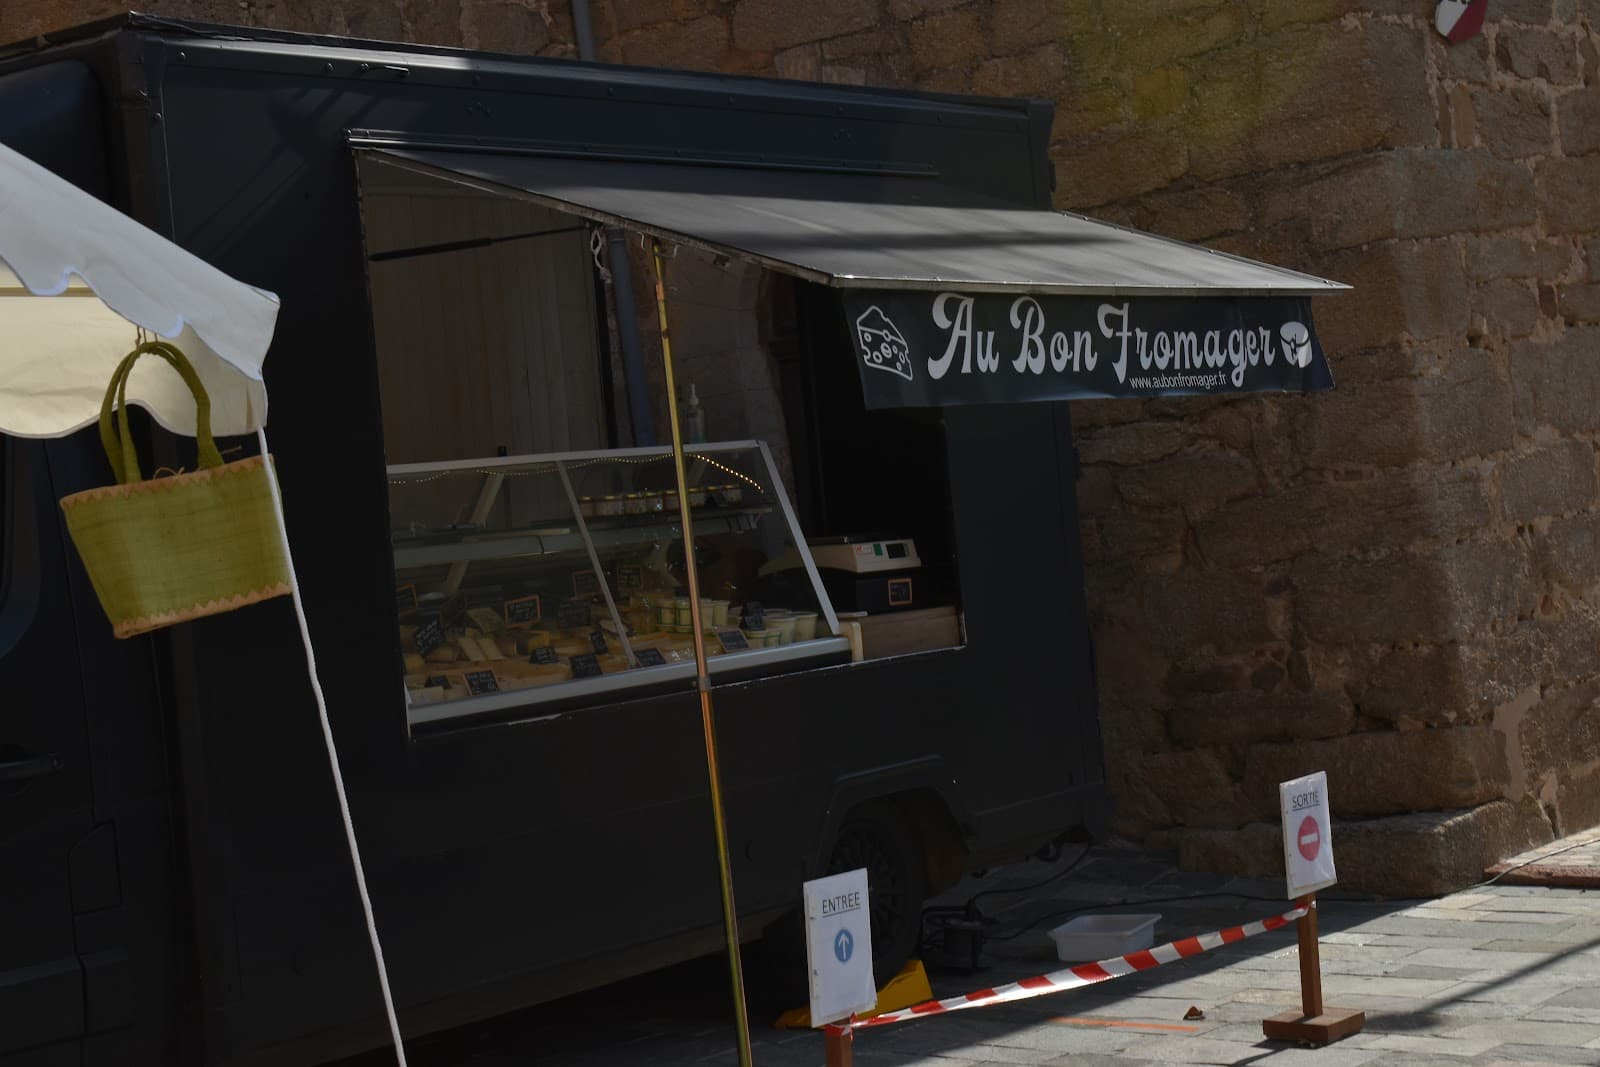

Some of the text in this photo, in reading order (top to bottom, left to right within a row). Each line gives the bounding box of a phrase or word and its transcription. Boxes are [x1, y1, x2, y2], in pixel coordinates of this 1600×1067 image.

[928, 292, 1277, 388] Au Bon Fromager
[1128, 371, 1227, 390] www.aubonfromager.fr
[1292, 791, 1320, 809] SORTIE
[822, 892, 861, 914] ENTREE
